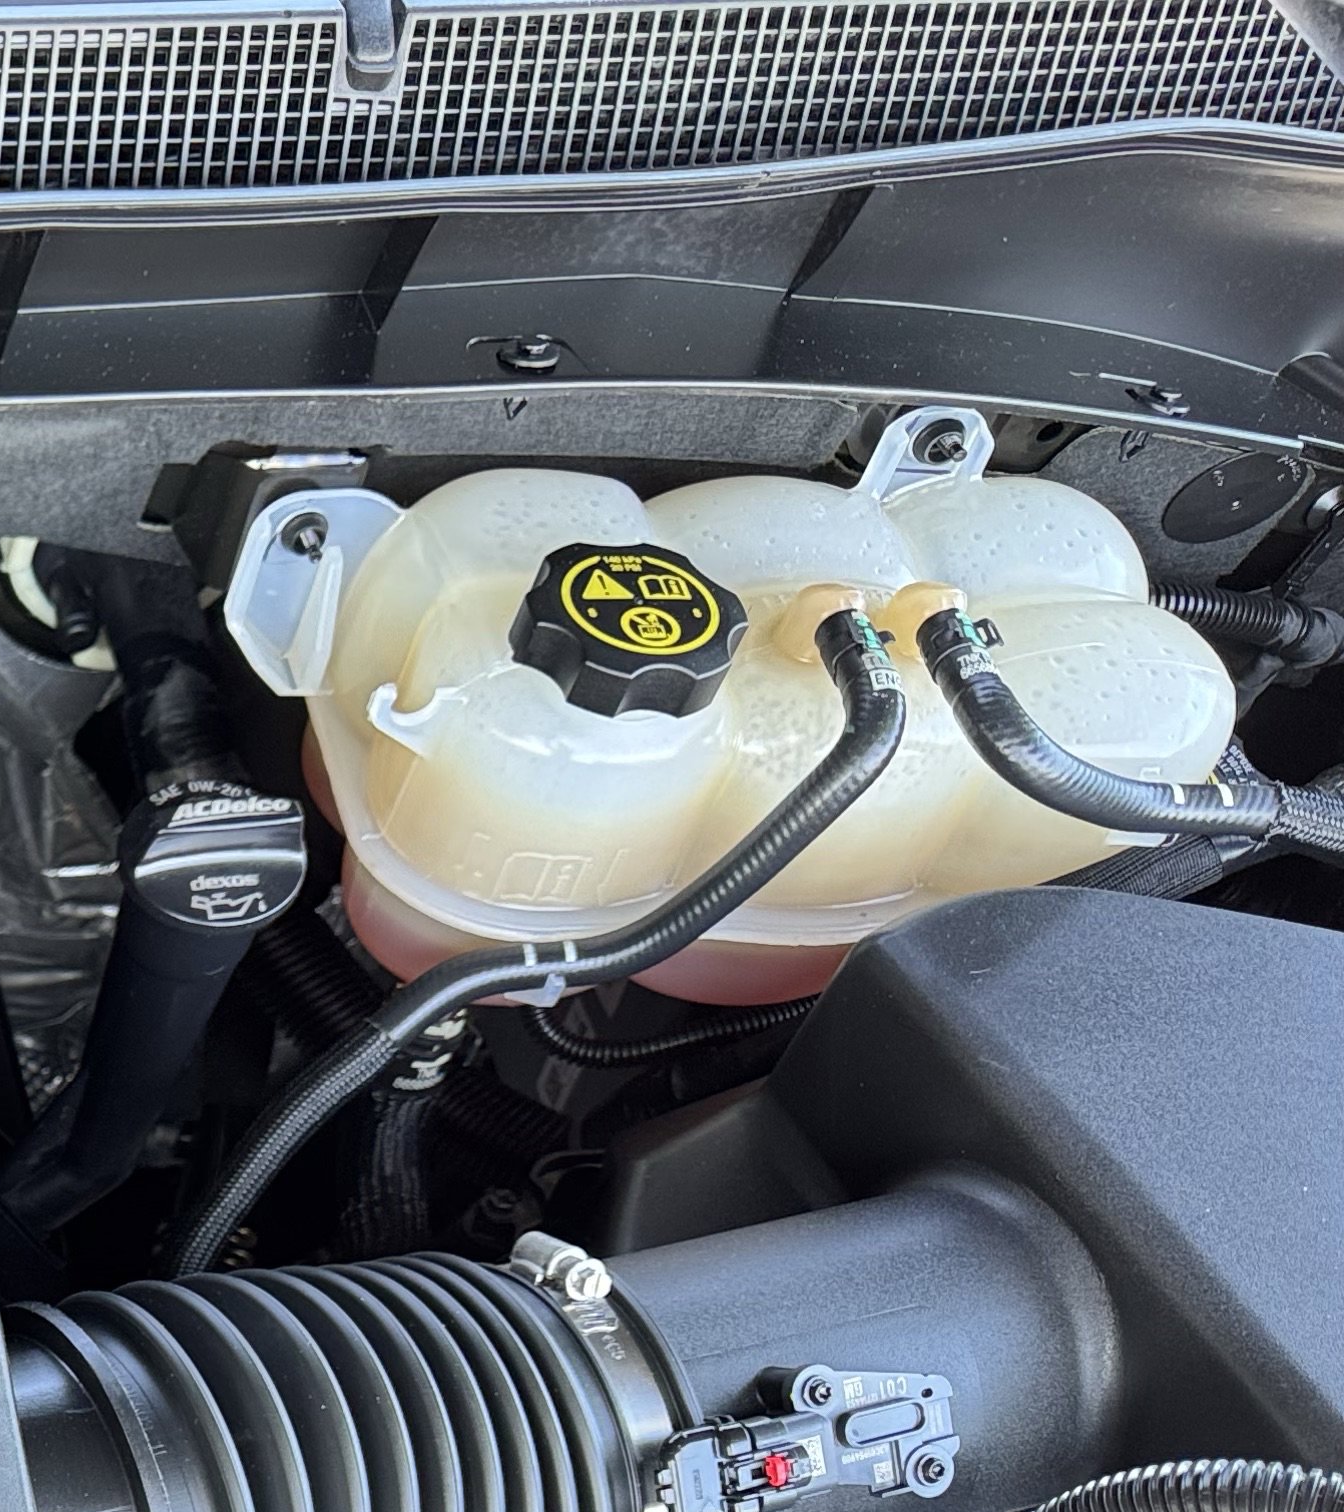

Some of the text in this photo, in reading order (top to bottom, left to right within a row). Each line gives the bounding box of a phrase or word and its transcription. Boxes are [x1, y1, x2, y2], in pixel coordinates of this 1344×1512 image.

[149, 784, 183, 806] SAE
[171, 797, 293, 822] ACDelco
[189, 874, 260, 891] dexos
[843, 1380, 864, 1400] GM
